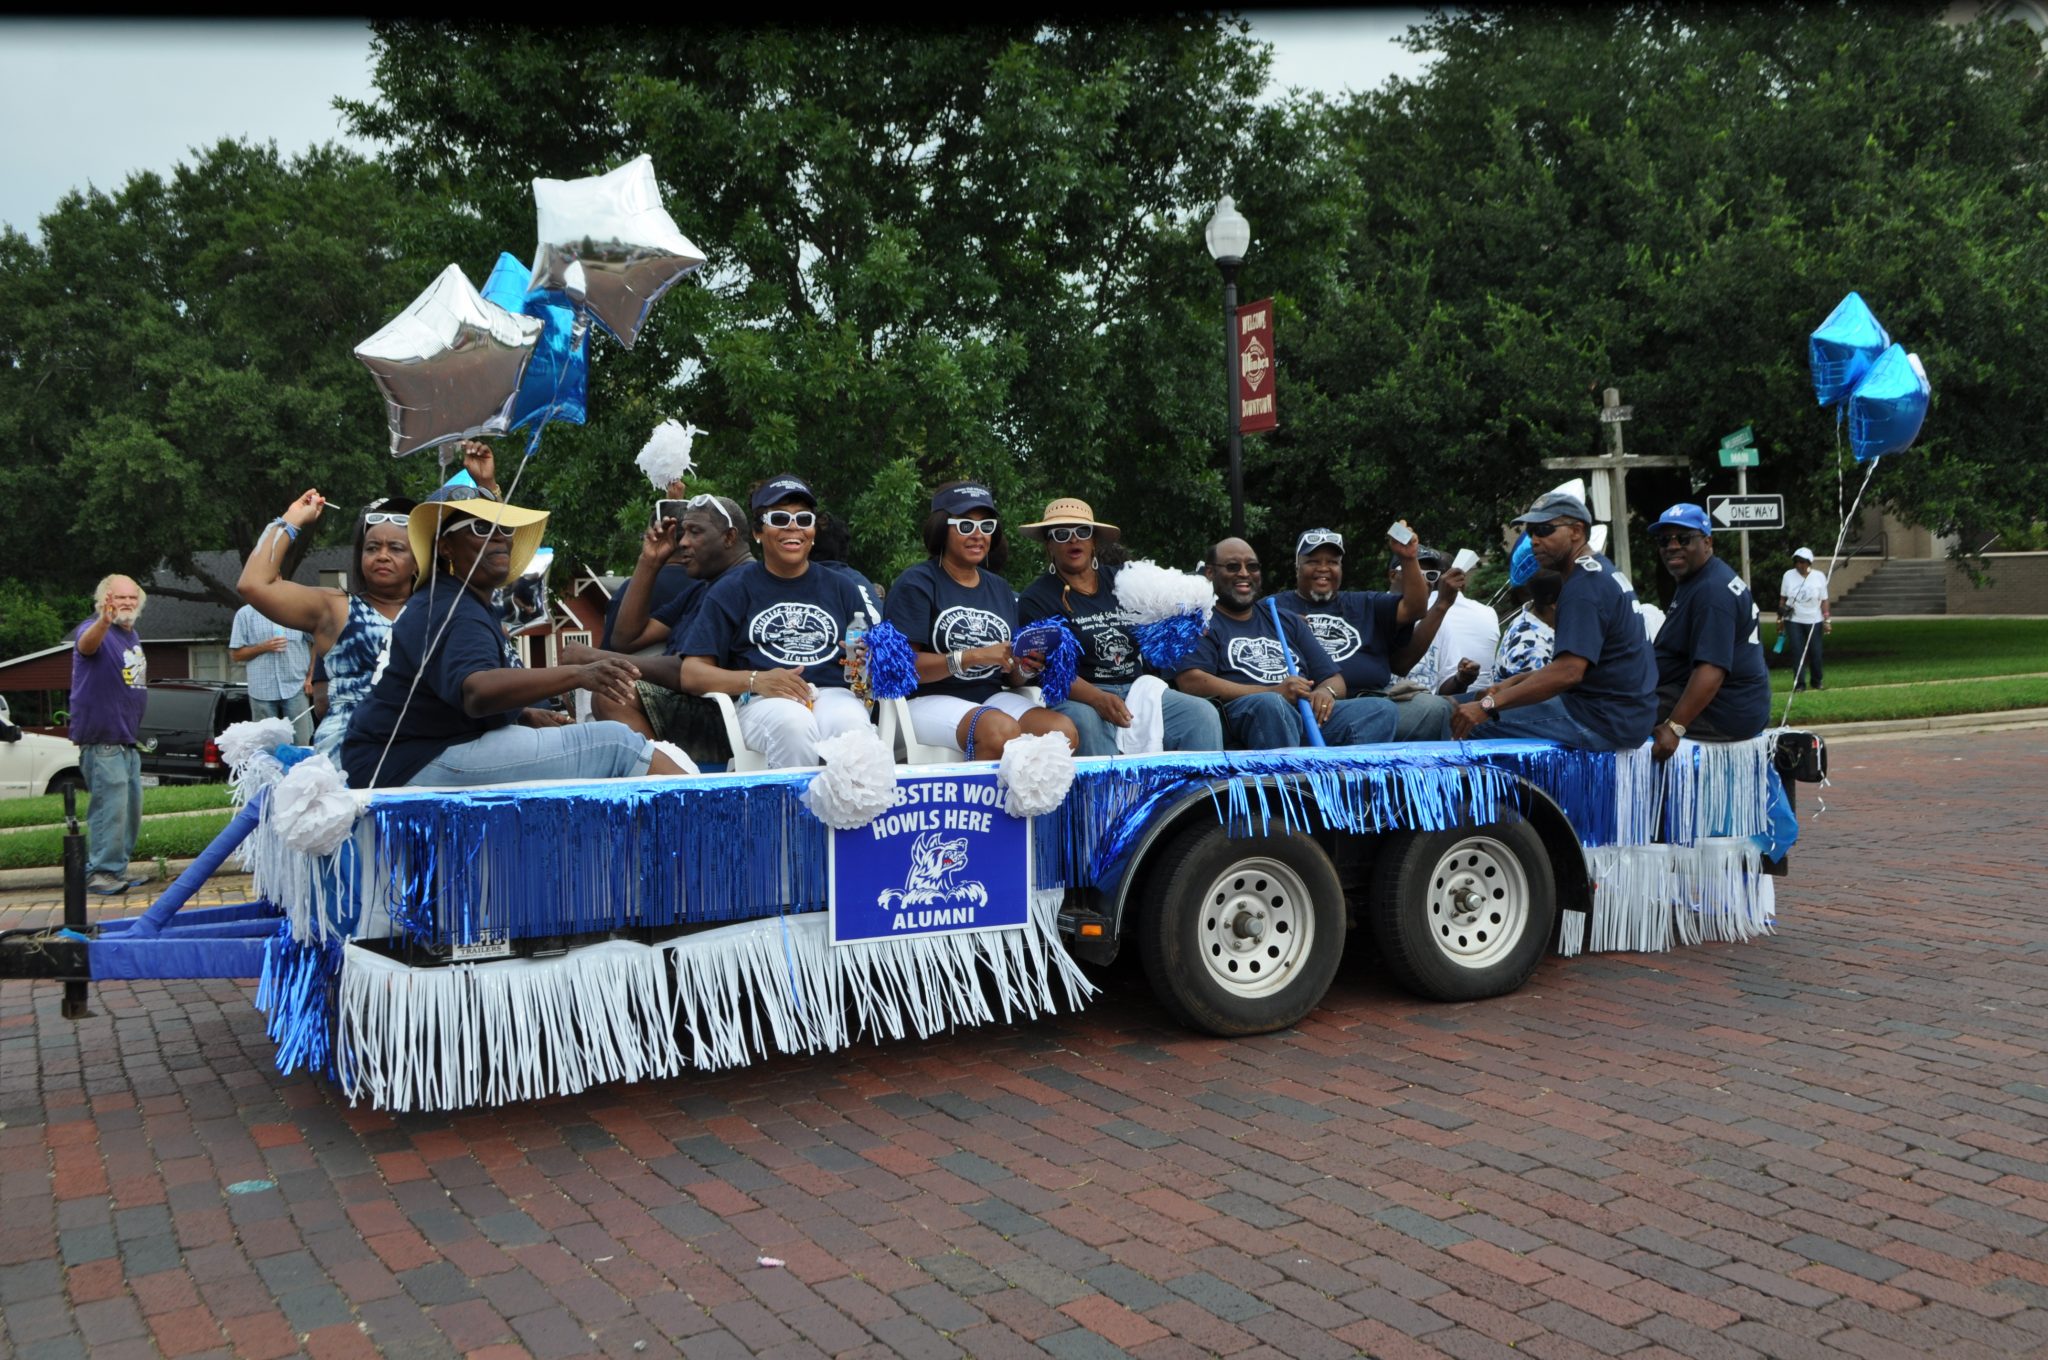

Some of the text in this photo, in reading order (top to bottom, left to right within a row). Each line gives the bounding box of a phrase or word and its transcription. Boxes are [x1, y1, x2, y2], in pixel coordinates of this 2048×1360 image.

[1241, 394, 1273, 417] DOWNTOWN
[1730, 506, 1775, 519] ONE WAY
[753, 607, 782, 635] Webster
[780, 653, 820, 662] Alumni
[890, 782, 1009, 809] BSTER WOL
[871, 809, 993, 841] HOWLS HERE
[892, 907, 975, 931] ALUMNI
[460, 945, 503, 955] TRAILERS
